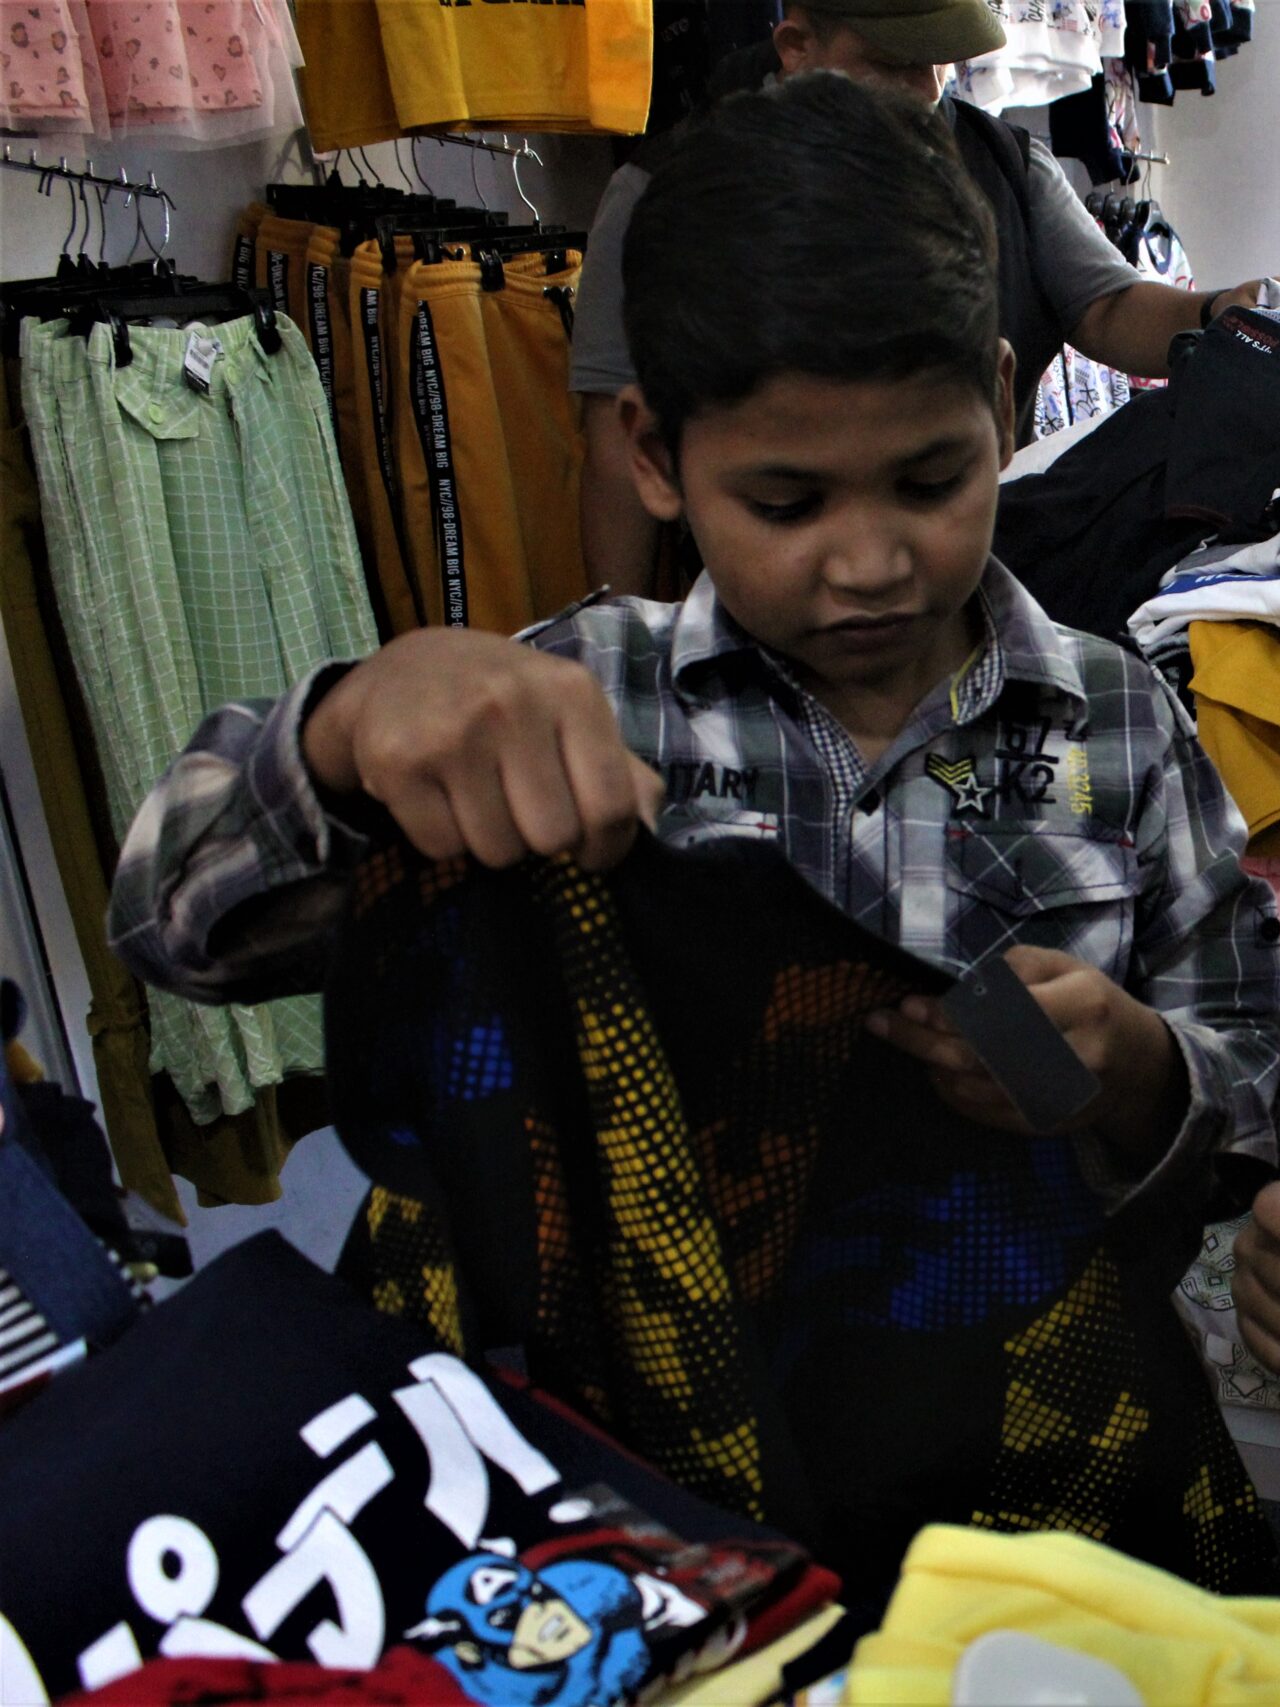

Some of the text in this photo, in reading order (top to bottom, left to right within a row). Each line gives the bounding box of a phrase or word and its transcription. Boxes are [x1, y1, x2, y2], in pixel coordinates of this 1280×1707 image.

[1235, 329, 1254, 343] ALL
[422, 349, 434, 366] BIG
[435, 451, 449, 468] BIG
[446, 558, 460, 575] BIG
